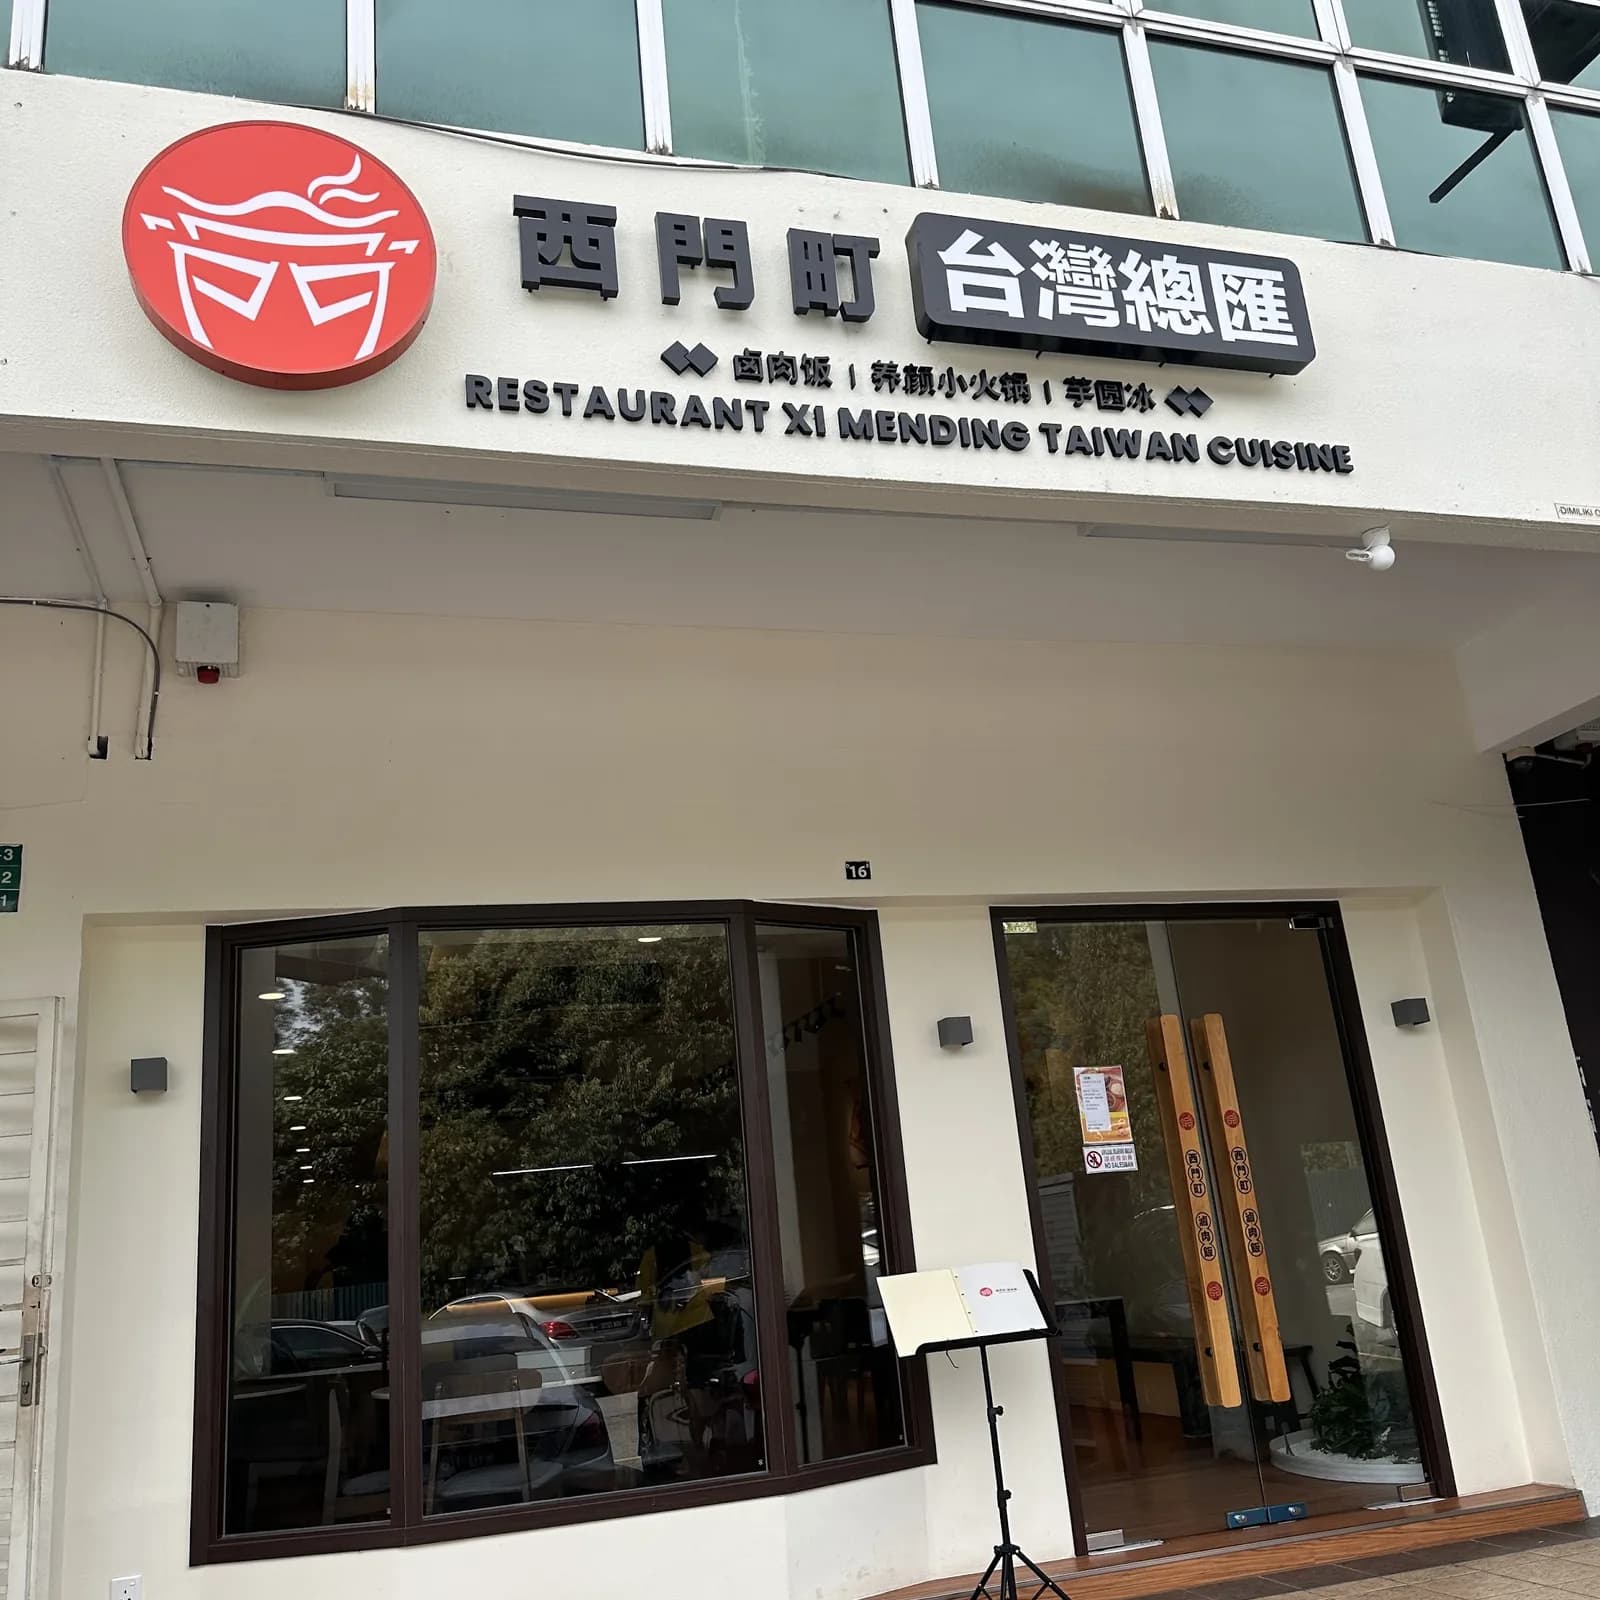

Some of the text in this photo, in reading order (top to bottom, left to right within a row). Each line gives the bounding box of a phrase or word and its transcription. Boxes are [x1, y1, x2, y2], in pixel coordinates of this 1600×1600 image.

[513, 194, 880, 323] 西門町
[937, 228, 1299, 347] 台灣總匯
[465, 373, 1354, 473] RESTAURANT XI MENDING TAIWAN CUISINE
[732, 346, 833, 389] 卤肉饭
[871, 359, 1032, 404] 养颜小火锅
[849, 865, 868, 878] 16
